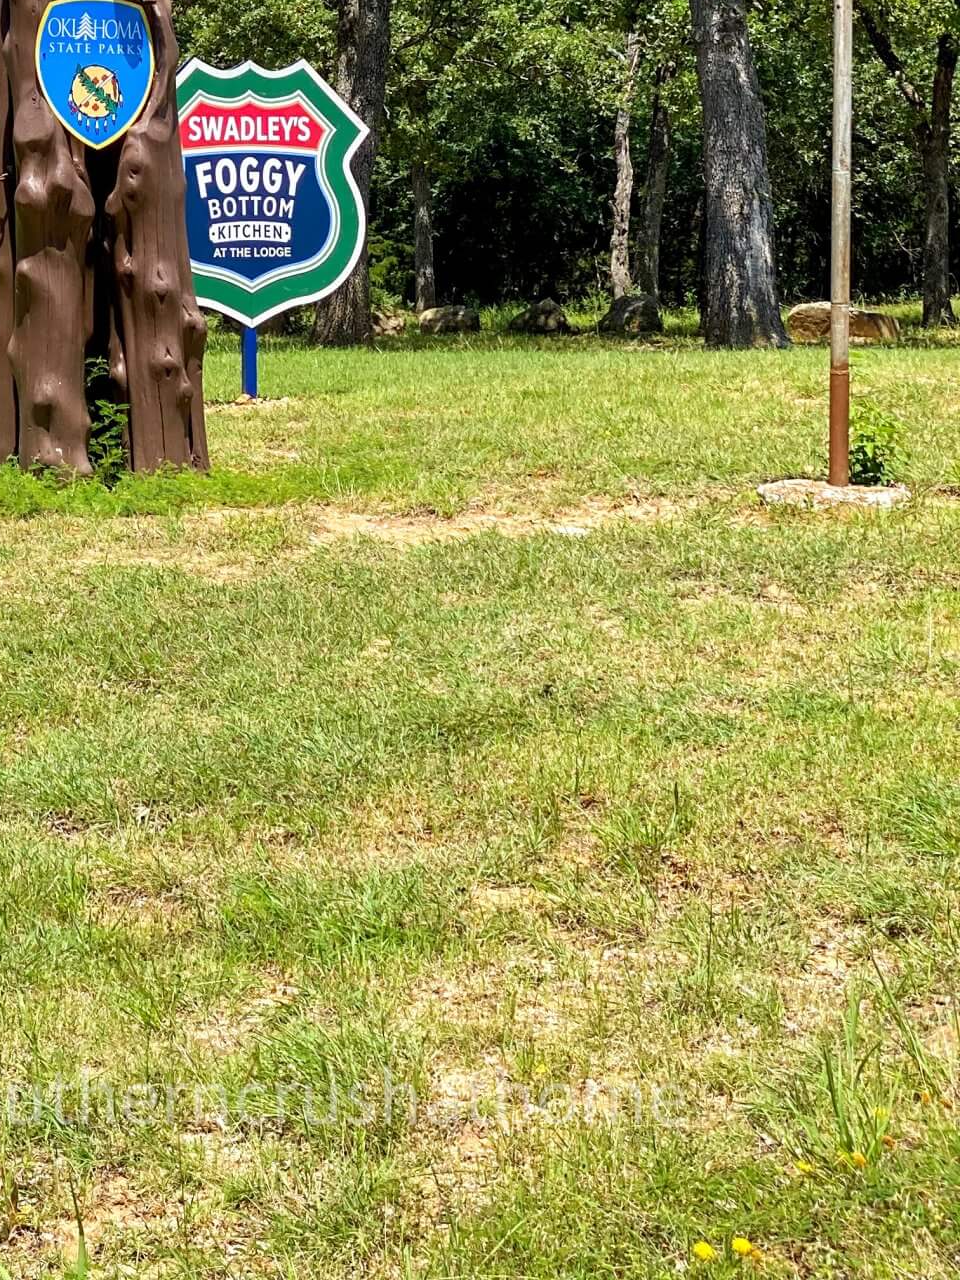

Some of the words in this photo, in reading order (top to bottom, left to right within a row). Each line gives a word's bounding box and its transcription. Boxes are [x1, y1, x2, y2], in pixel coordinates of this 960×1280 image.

[47, 12, 142, 41] OKLAHOMA
[49, 42, 91, 54] STATE
[99, 44, 142, 55] PARKS
[189, 116, 311, 142] SWADLEY'S
[195, 157, 306, 199] FOGGY
[208, 196, 295, 220] BOTTOM
[217, 224, 283, 240] KITCHEN
[213, 248, 229, 258] AT
[231, 248, 252, 258] THE
[254, 247, 291, 257] LODGE
